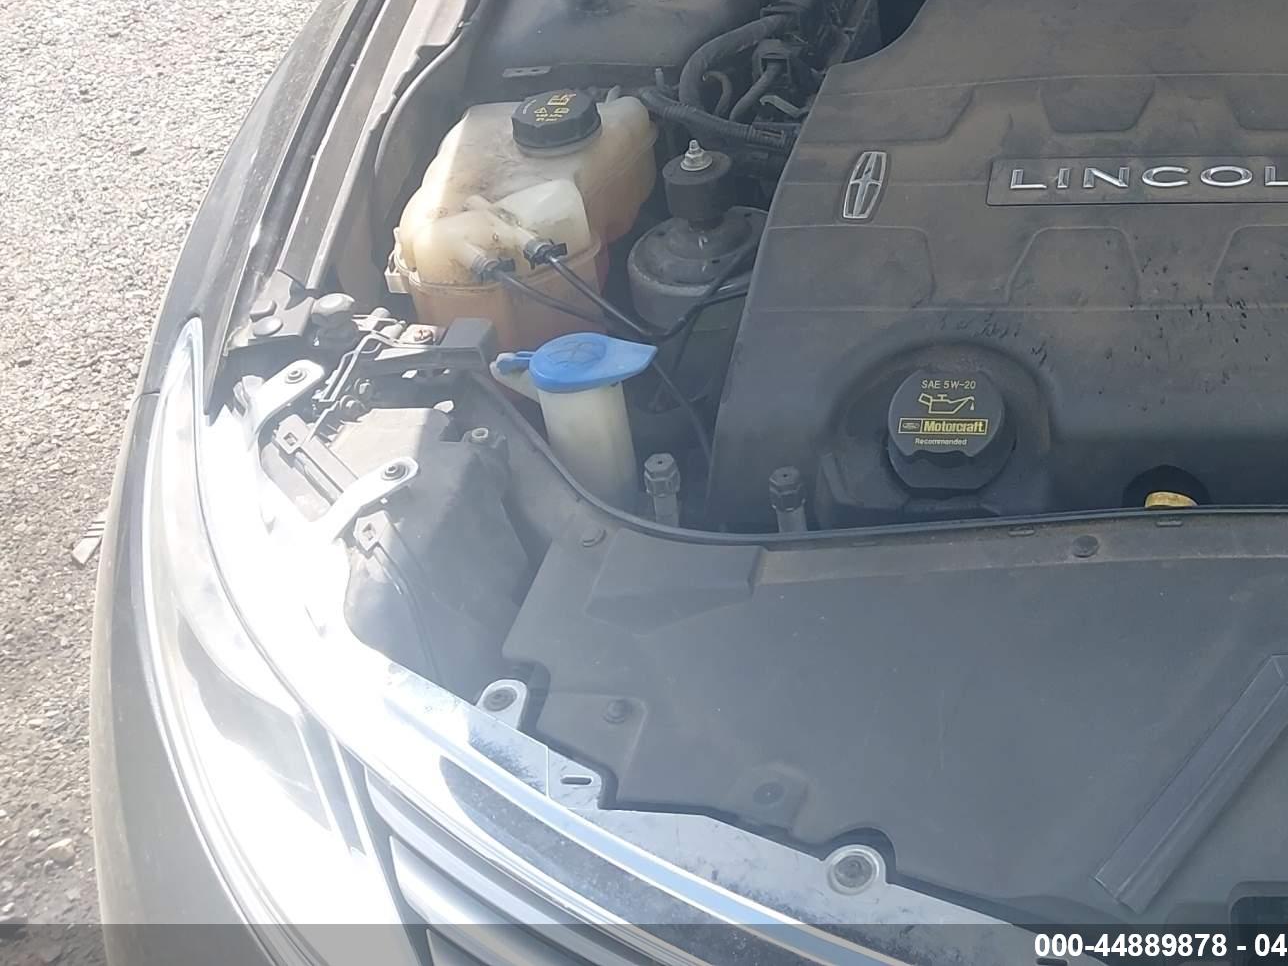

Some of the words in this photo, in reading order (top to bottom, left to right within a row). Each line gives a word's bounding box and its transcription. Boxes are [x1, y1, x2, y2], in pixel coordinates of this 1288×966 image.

[921, 380, 941, 390] SAE
[943, 379, 977, 390] 5W-20
[924, 421, 985, 433] Motorcraft
[914, 437, 968, 446] Recommended
